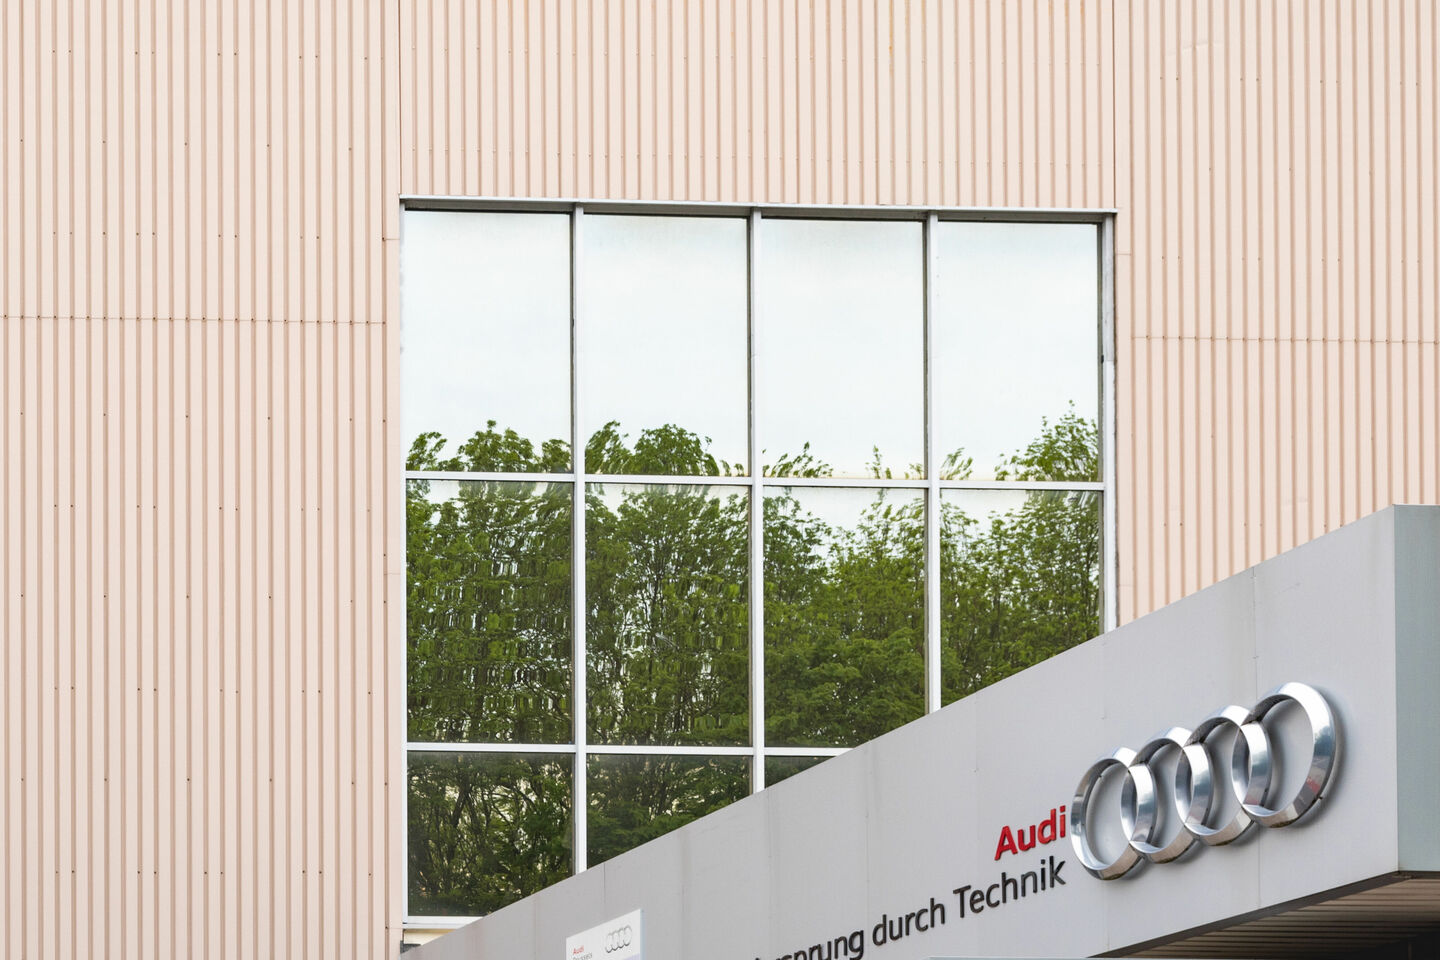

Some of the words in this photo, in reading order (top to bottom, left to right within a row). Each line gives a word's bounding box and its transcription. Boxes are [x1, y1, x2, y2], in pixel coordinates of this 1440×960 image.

[994, 805, 1067, 861] Audi
[871, 897, 946, 947] durch
[952, 855, 1067, 918] Technik
[573, 945, 585, 955] Audi
